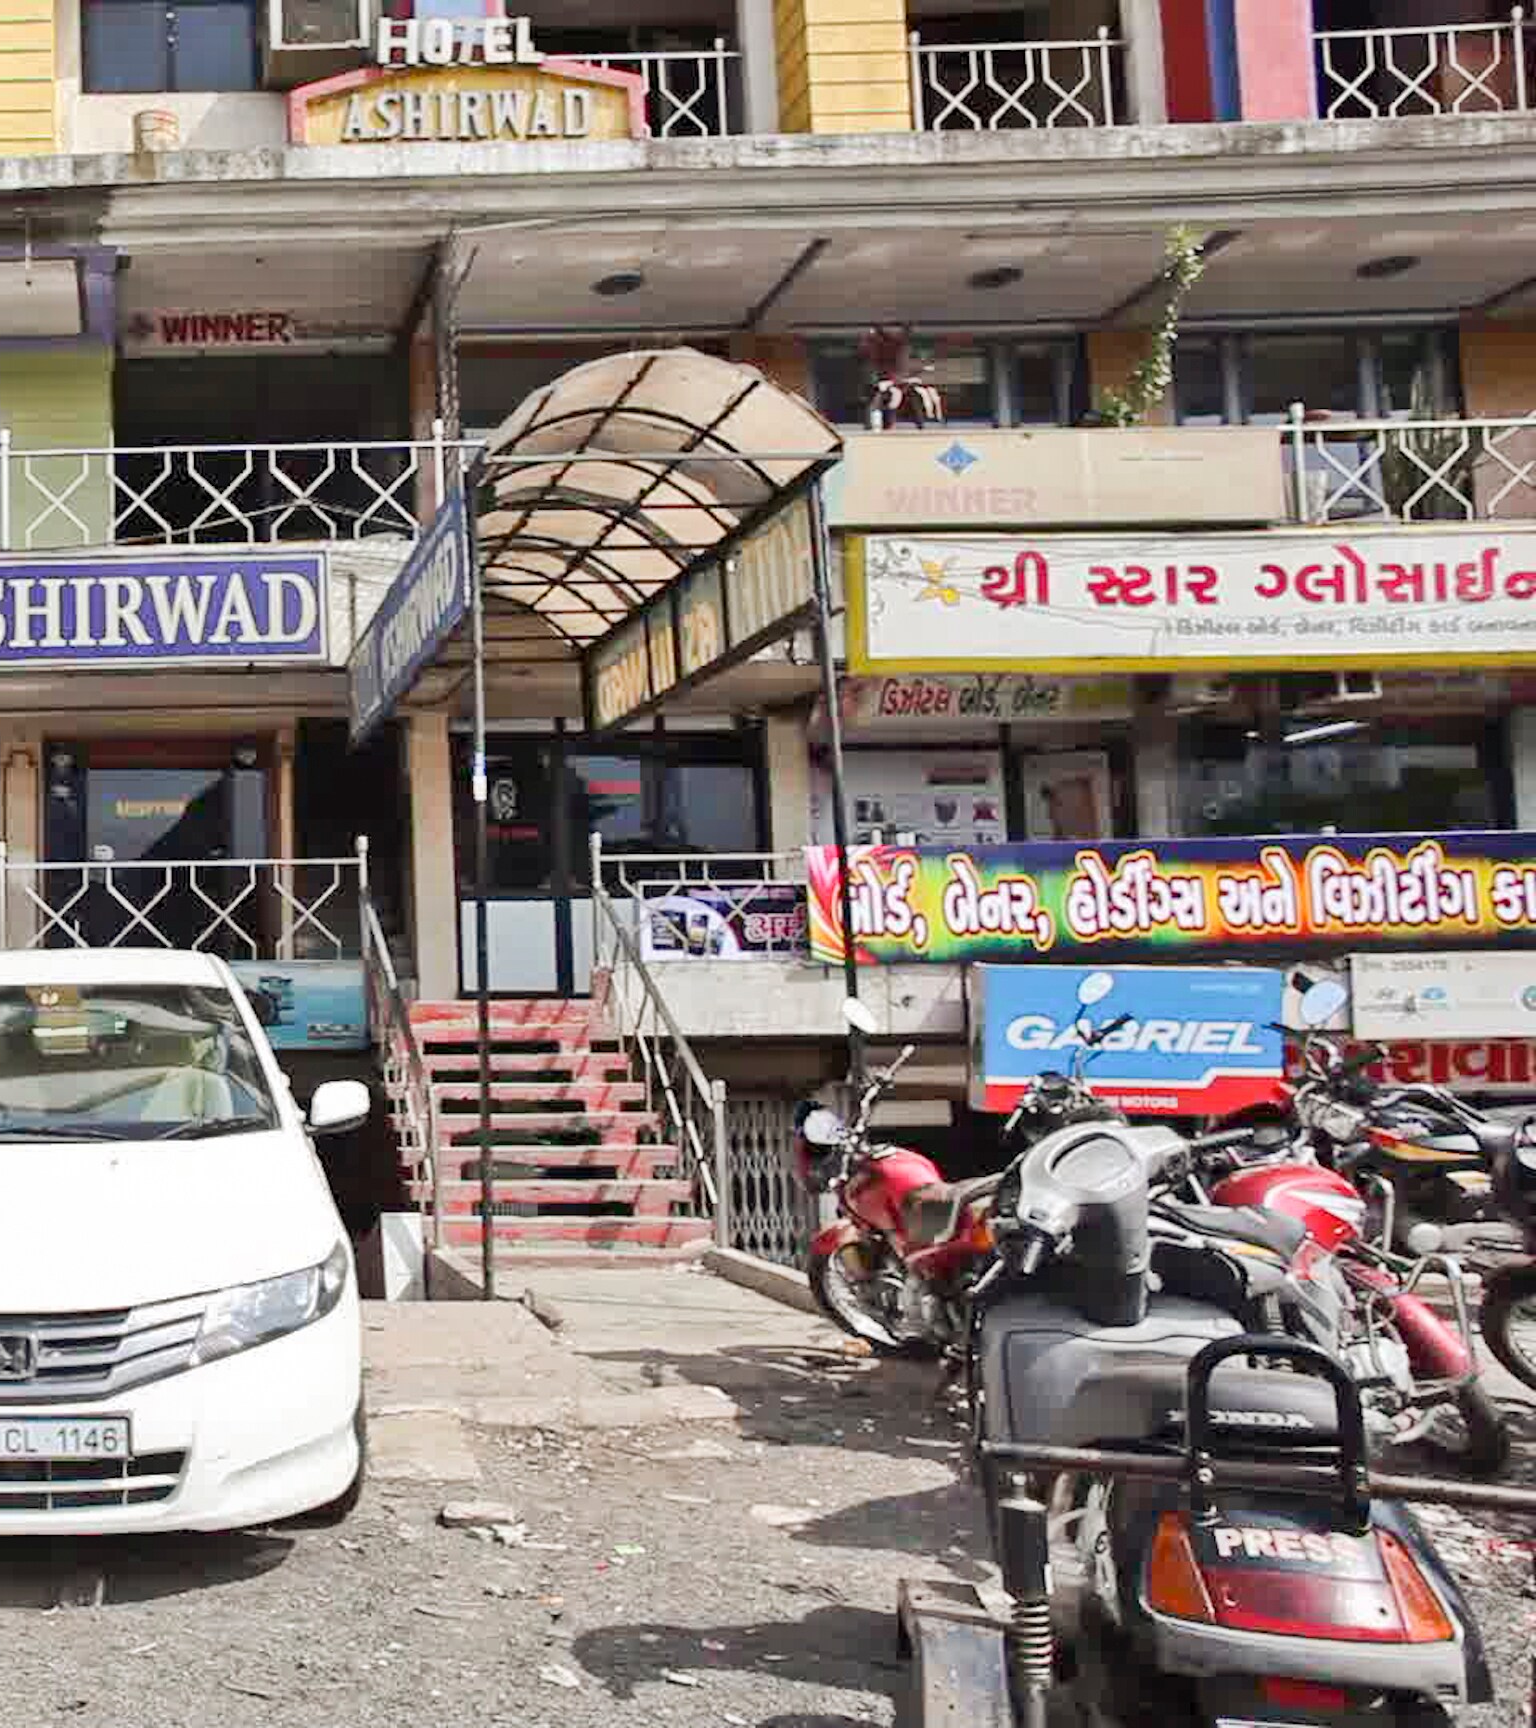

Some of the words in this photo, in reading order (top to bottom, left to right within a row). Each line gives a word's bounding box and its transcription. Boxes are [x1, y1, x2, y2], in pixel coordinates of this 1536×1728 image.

[378, 16, 546, 66] HOTEL
[342, 89, 591, 141] ASHIRWAD
[161, 313, 291, 343] WINNER
[881, 486, 1038, 514] WINNER
[1087, 565, 1219, 605] સ્ટાર
[945, 858, 1052, 946] બેનર,
[1218, 853, 1297, 927] અને
[1005, 1014, 1265, 1055] GABRIEL
[4, 1428, 39, 1454] CL
[57, 1426, 119, 1454] 1146
[1213, 1527, 1367, 1568] PRESS
